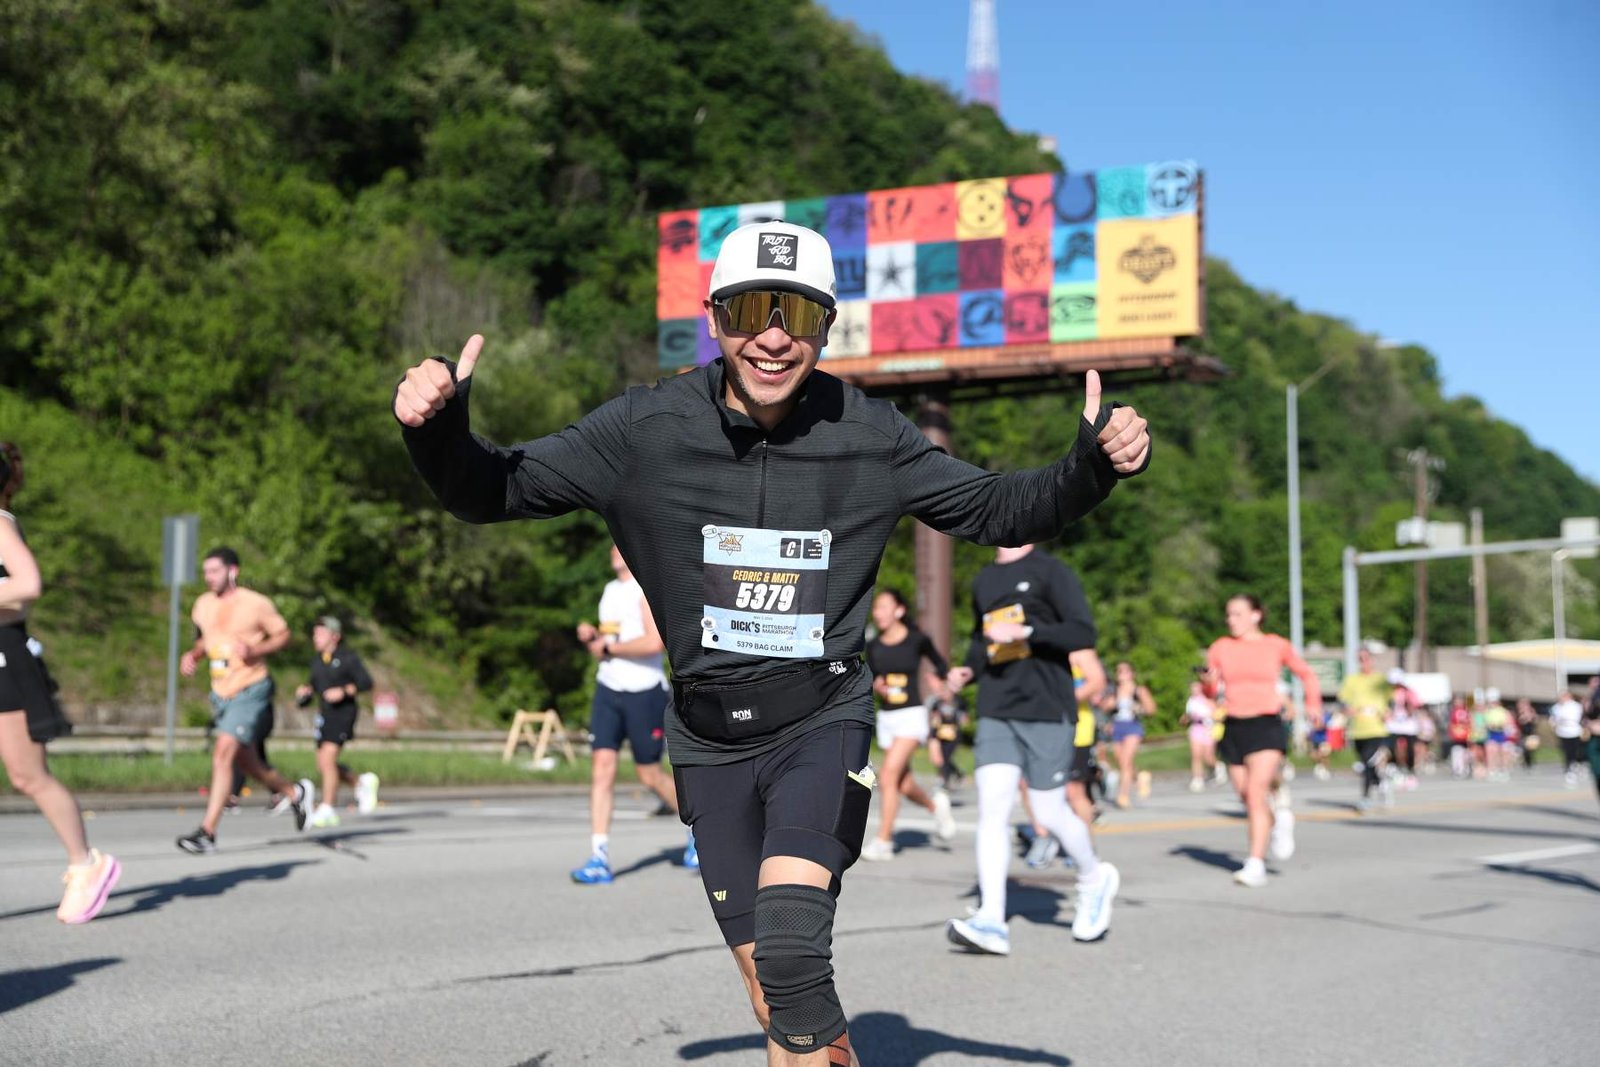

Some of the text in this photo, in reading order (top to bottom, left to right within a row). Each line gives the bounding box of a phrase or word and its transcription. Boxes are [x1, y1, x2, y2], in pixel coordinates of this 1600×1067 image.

[761, 235, 794, 246] TRUST
[769, 246, 791, 255] GOD
[773, 255, 794, 266] BRO
[732, 569, 800, 584] CEDRIC & MATTY
[735, 582, 796, 612] 5379
[731, 619, 761, 633] DICK'S
[736, 640, 753, 649] 5379
[754, 643, 769, 651] BAG
